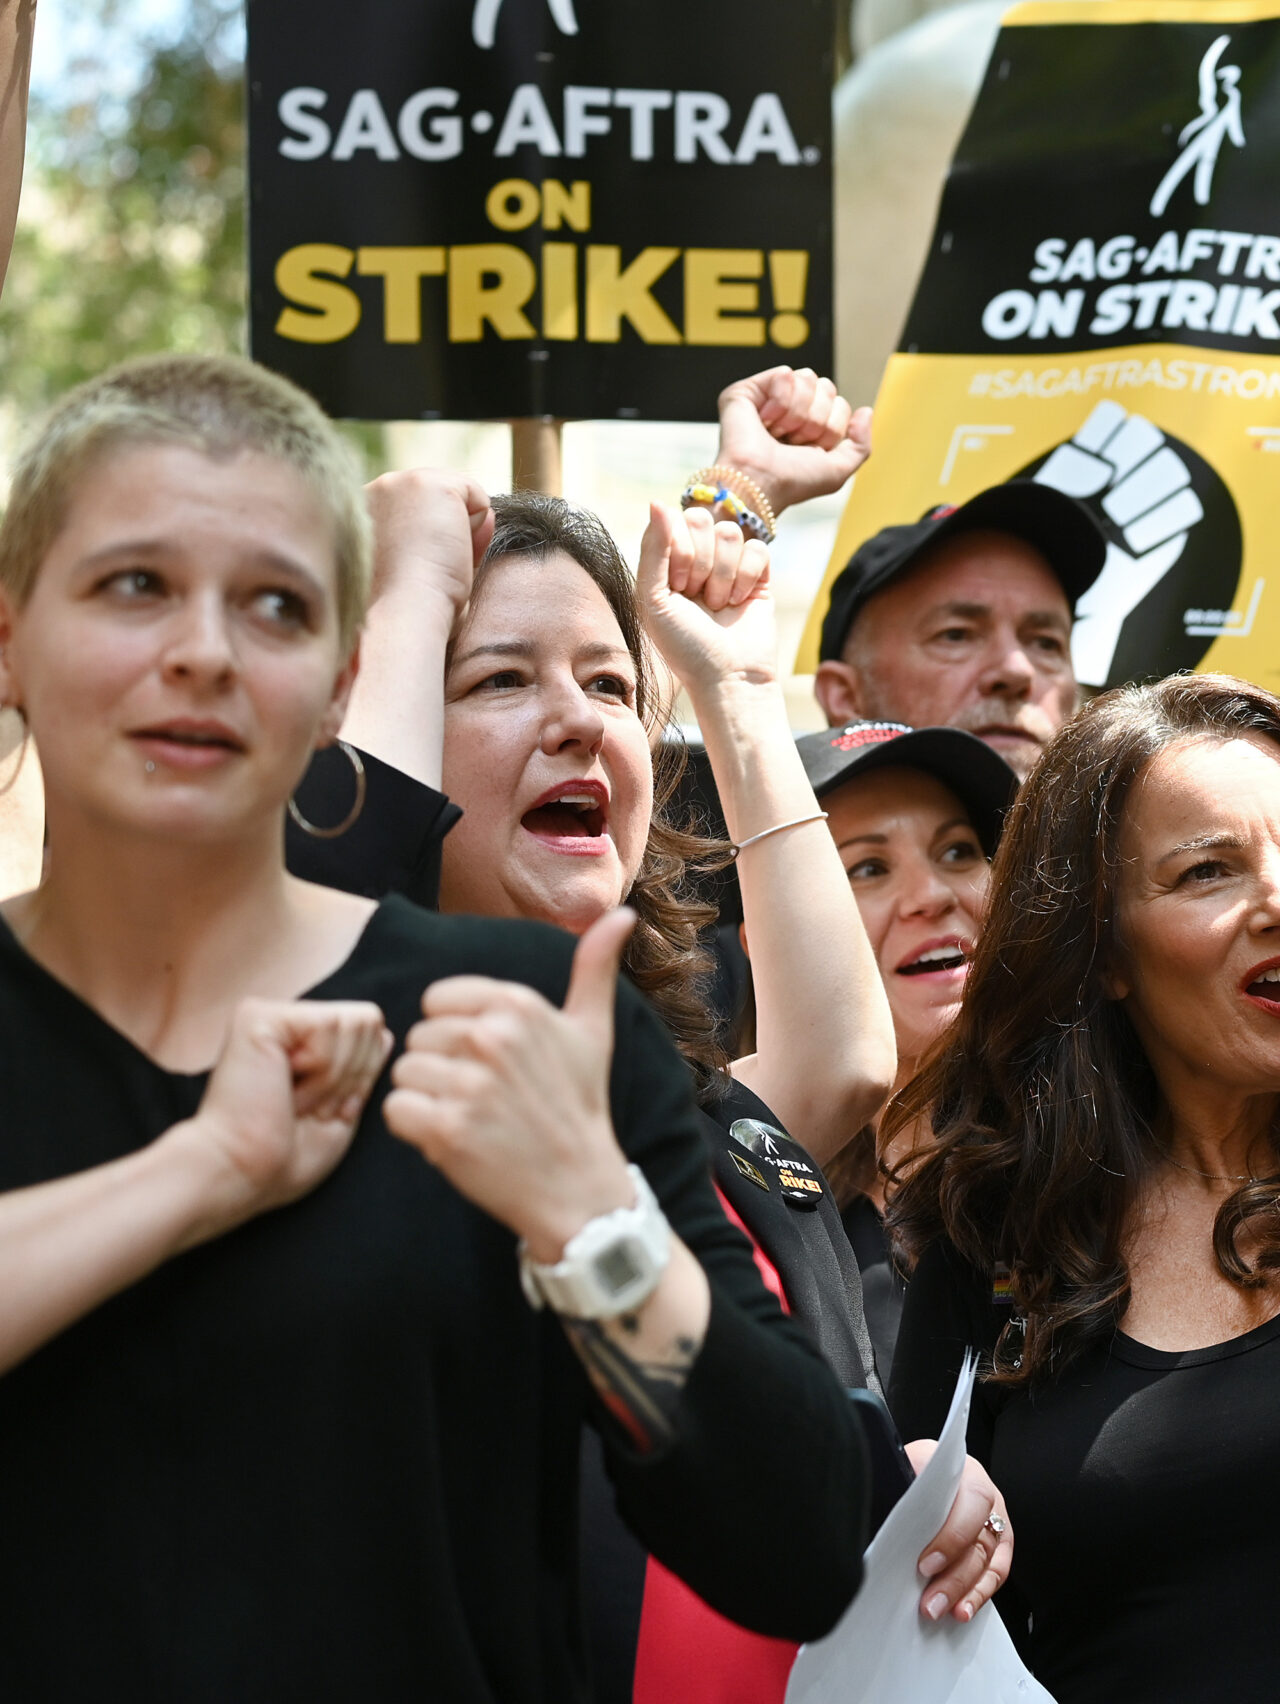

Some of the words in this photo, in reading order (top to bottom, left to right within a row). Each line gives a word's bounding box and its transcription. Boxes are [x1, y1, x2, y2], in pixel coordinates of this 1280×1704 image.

[278, 84, 802, 165] SAG·AFTRA
[485, 178, 591, 232] ON
[274, 242, 810, 349] STRIKE!
[981, 288, 1086, 341] ON
